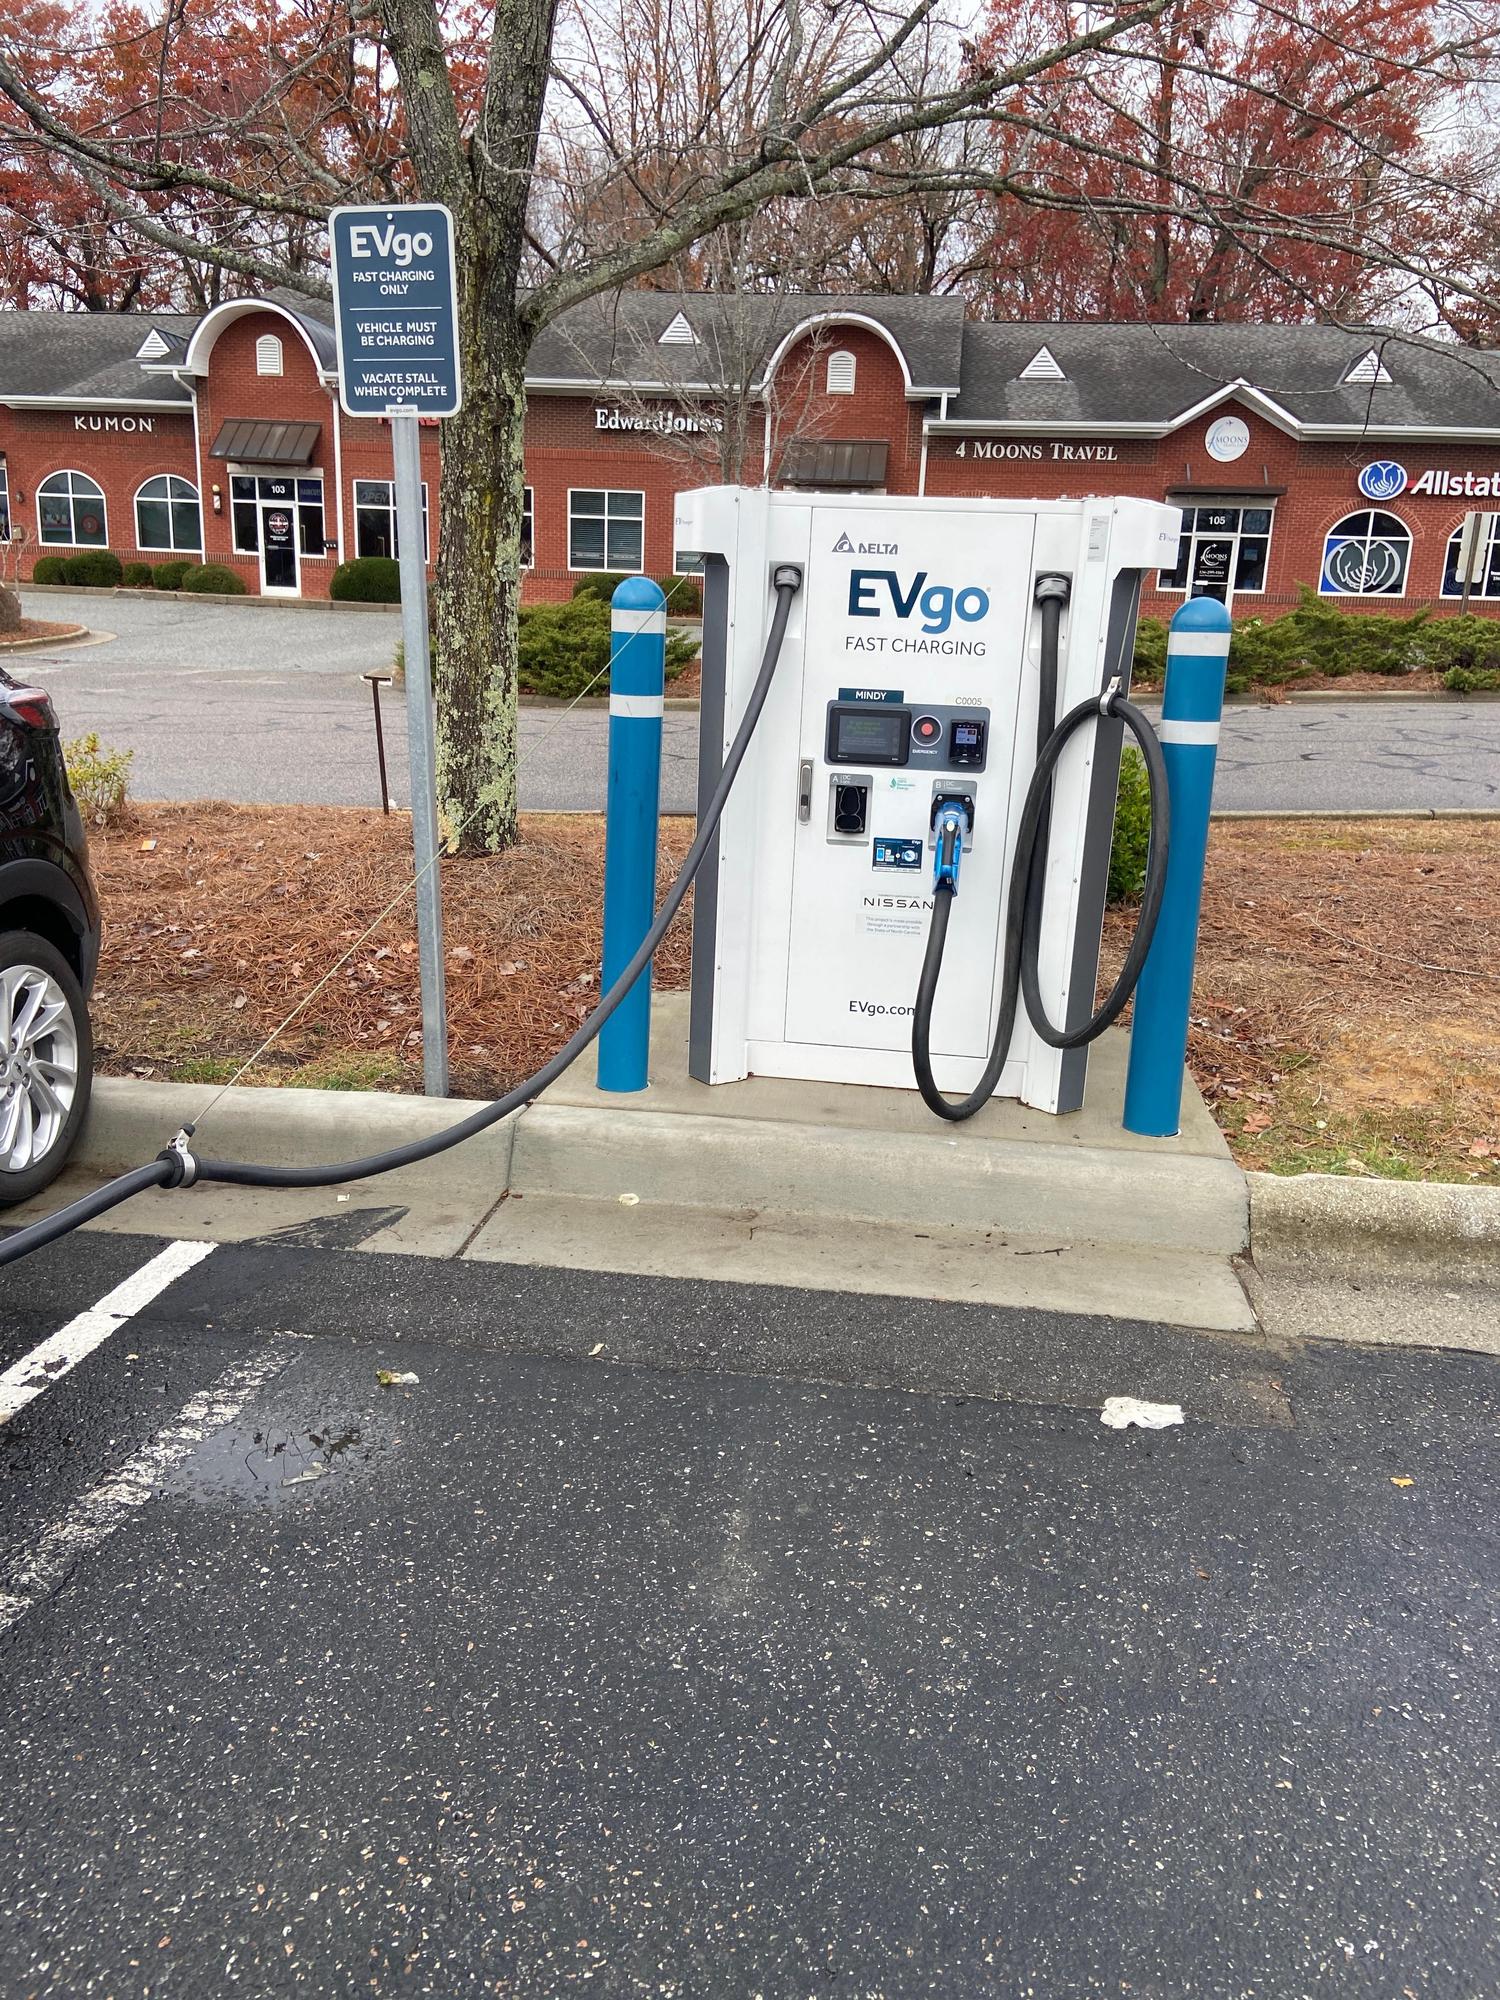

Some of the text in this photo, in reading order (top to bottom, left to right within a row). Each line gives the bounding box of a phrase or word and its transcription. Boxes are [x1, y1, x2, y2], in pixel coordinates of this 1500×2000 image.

[349, 224, 433, 266] EVgo
[352, 270, 435, 282] FAST CHARGING
[379, 284, 409, 295] ONLY
[356, 321, 437, 333] VEHICLE MUST
[361, 334, 435, 346] BE CHARGING
[361, 372, 438, 384] VACATE STALL
[354, 385, 448, 397] WHEN COMPLETE
[74, 416, 153, 432] KUMON
[955, 441, 1118, 461] 4 MOONS TRAVEL
[271, 485, 286, 494] 103
[1208, 516, 1226, 525] 105
[858, 542, 899, 555] DELTA
[848, 569, 990, 635] EVgo
[845, 636, 986, 656] FAST CHARGING
[855, 691, 887, 701] MINDY
[832, 775, 839, 783] A
[935, 781, 942, 789] B
[863, 897, 934, 910] NISSAN
